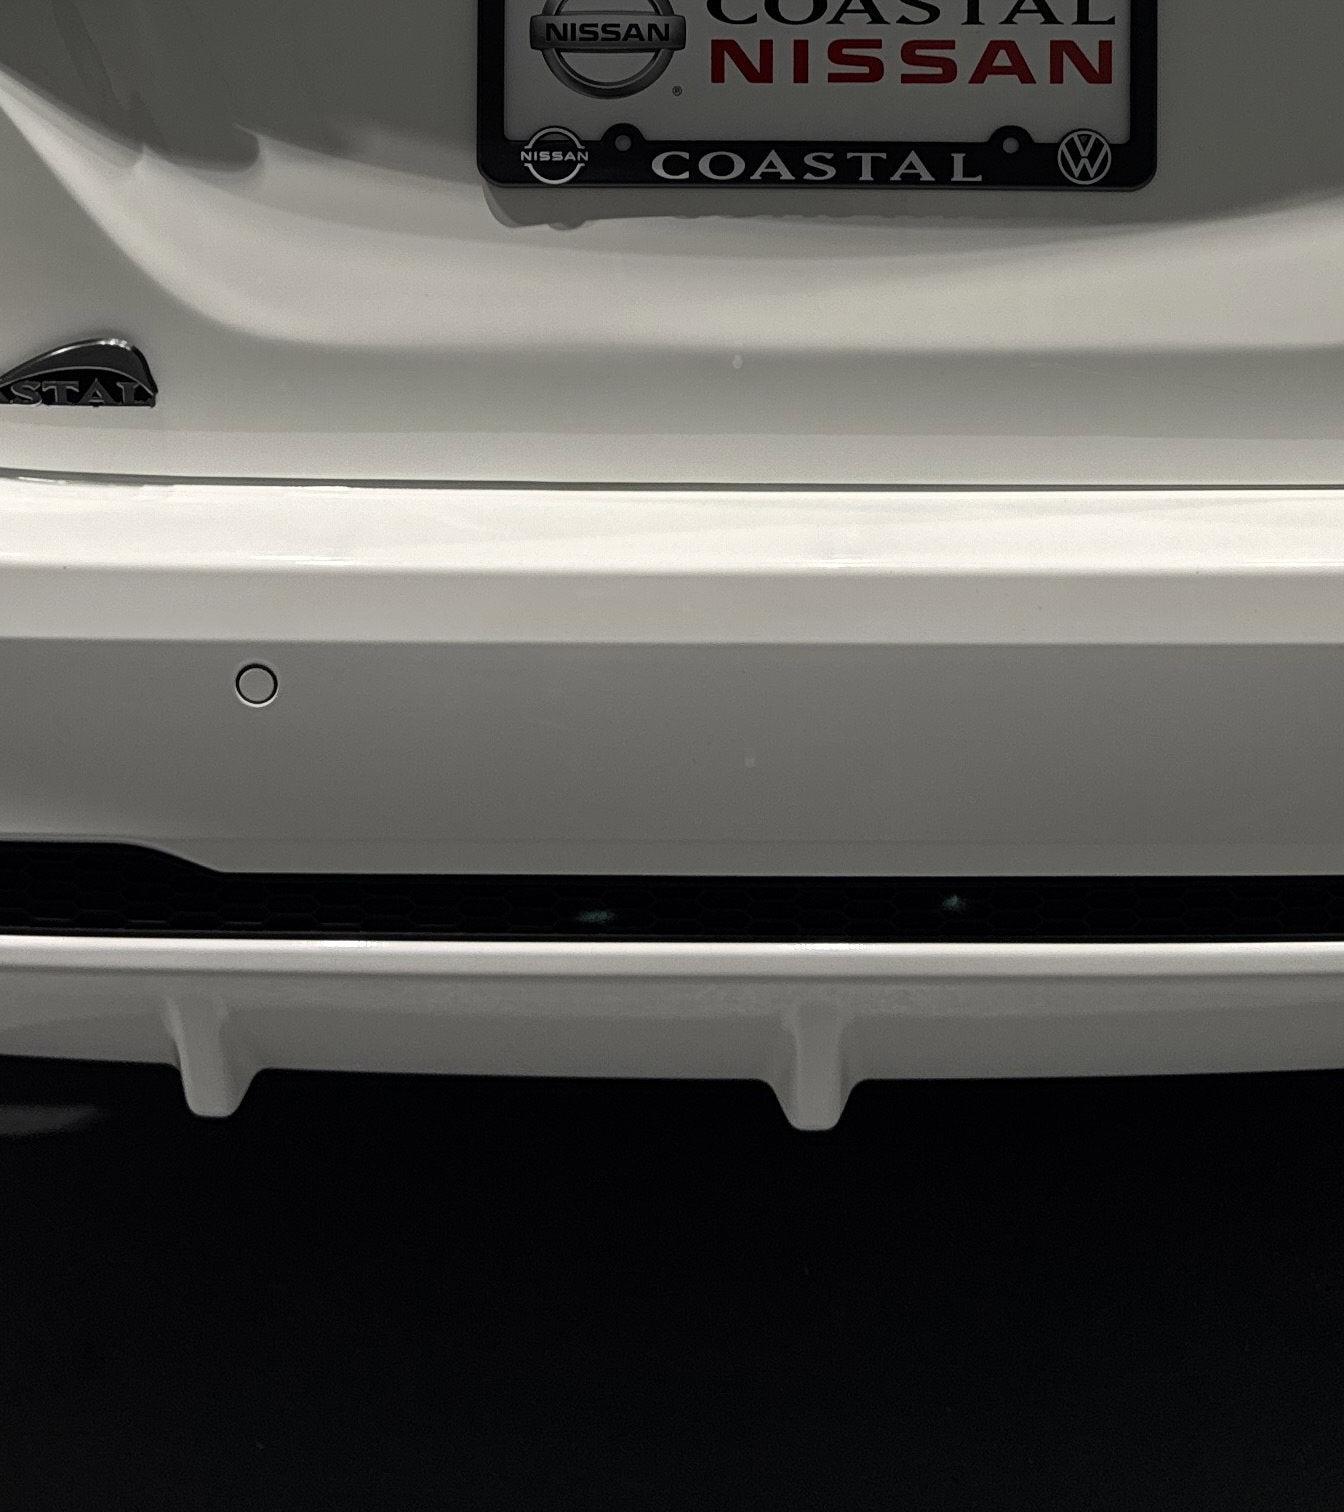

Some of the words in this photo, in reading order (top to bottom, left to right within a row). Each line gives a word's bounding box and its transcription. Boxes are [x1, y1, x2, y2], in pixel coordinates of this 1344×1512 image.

[545, 22, 670, 42] NISSAN
[710, 39, 1114, 85] NISSAN
[520, 150, 589, 162] NISSAN
[650, 148, 983, 182] COASTAL
